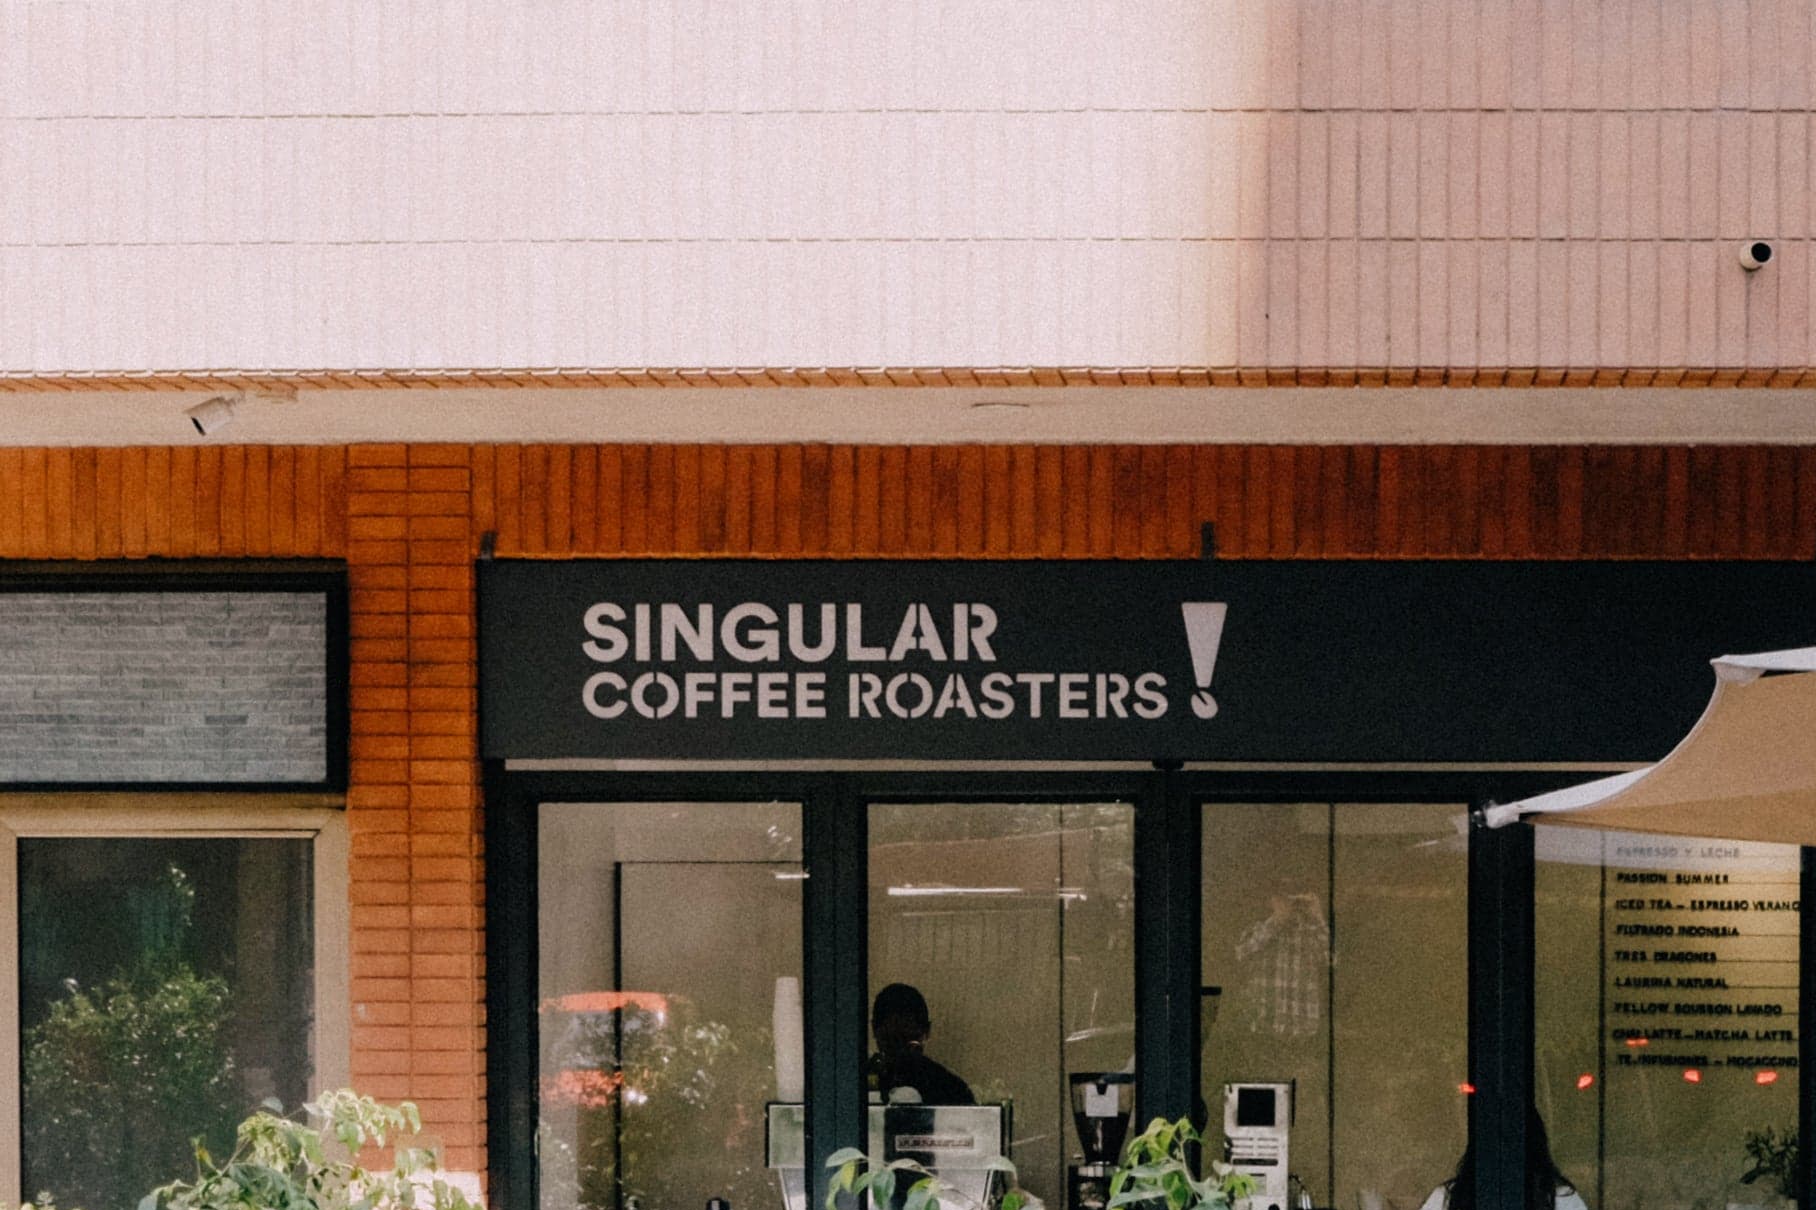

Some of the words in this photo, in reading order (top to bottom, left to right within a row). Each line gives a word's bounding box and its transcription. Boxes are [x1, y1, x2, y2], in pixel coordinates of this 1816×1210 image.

[582, 601, 998, 662] SINGULAR
[582, 671, 827, 720] COFFEE
[849, 671, 1169, 720] ROASTERS
[1701, 848, 1740, 858] LECHE
[1616, 872, 1667, 884] PASSION
[1676, 873, 1729, 885] SUMMER
[1615, 899, 1645, 911] ICED
[1651, 900, 1672, 911] TEA
[1691, 900, 1749, 911] ESPRESSO
[1616, 925, 1674, 937] FILTRADO
[1678, 926, 1740, 937] INDONESIA
[1615, 950, 1647, 962] TRES
[1654, 951, 1717, 963] DRAGONES
[1677, 978, 1728, 989] NATURAL
[1614, 1003, 1669, 1014] YELLOW
[1675, 1003, 1732, 1015] BOURBON
[1737, 1004, 1782, 1015] LAVADO
[1644, 1028, 1682, 1040] LATTE
[1695, 1029, 1749, 1041] MATCHA
[1756, 1029, 1792, 1041] LATTE
[1727, 1055, 1798, 1067] MOCACCINO
